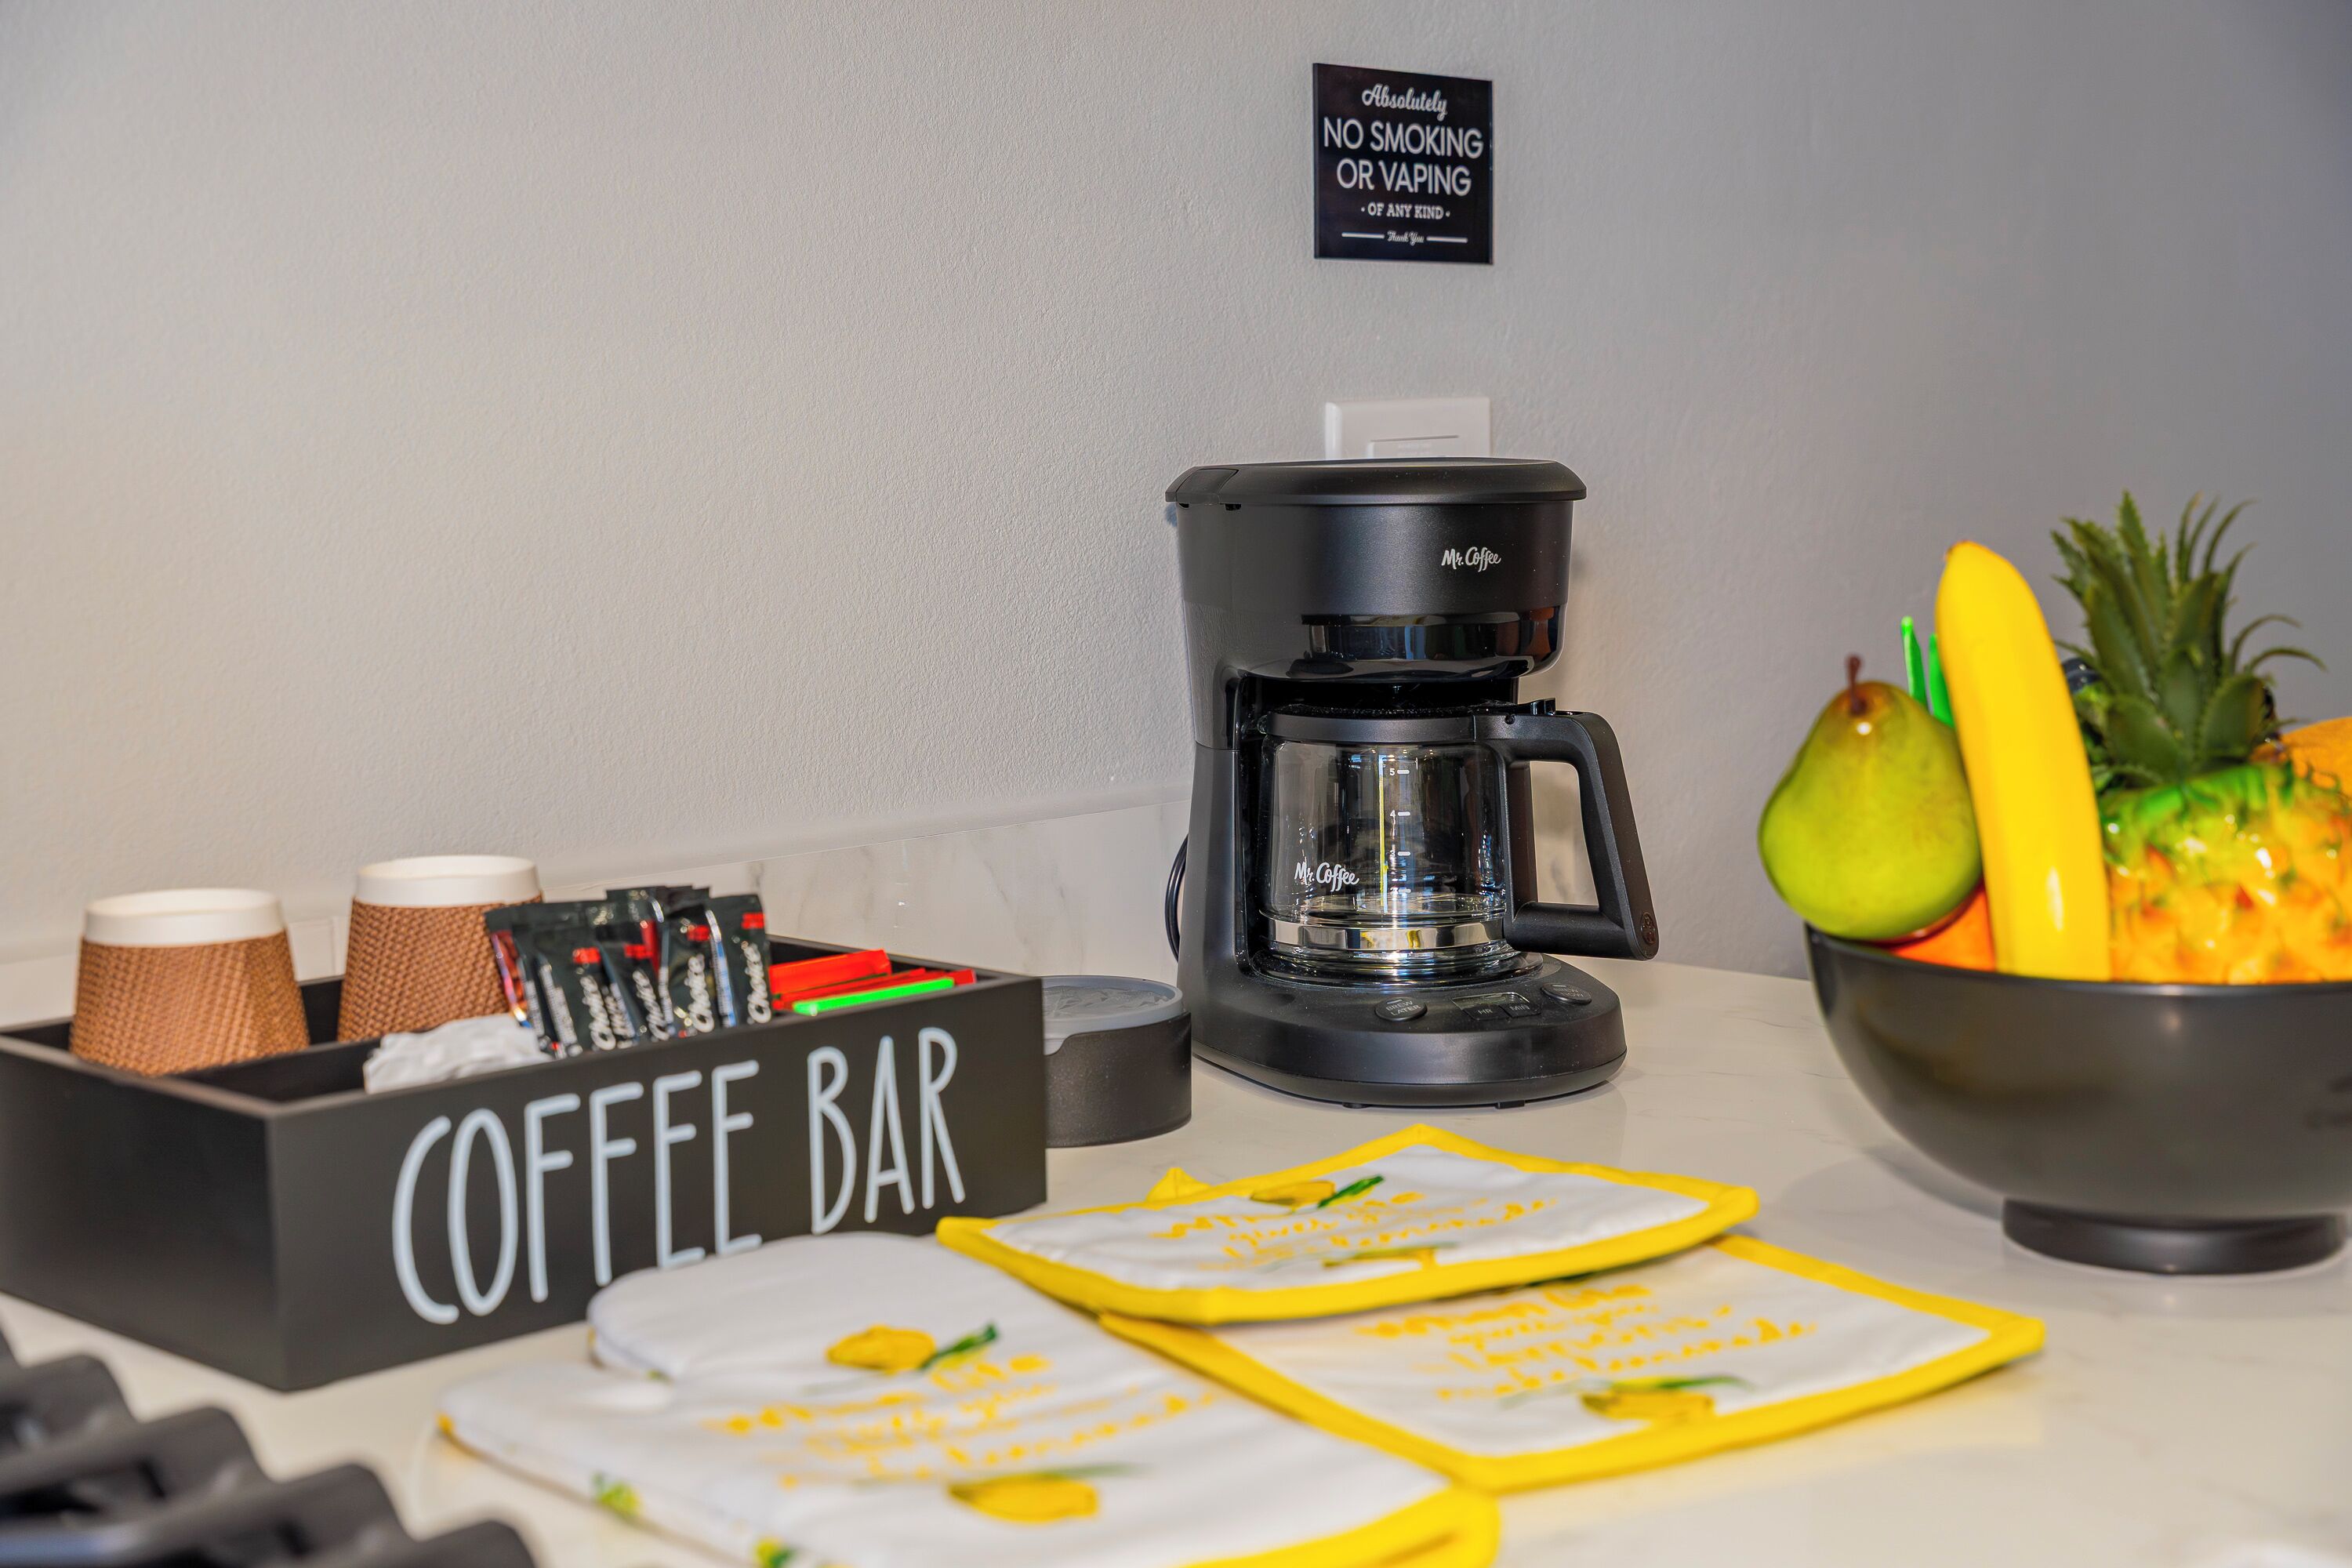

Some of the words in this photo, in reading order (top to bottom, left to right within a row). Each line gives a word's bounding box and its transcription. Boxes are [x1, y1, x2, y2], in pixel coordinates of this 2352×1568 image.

[1362, 83, 1448, 122] Absolutely
[1323, 117, 1364, 150] NO
[1370, 120, 1484, 159] SMOKING
[1337, 158, 1374, 190] OR
[1378, 160, 1472, 196] VAPING
[1367, 201, 1385, 216] OF
[1386, 202, 1413, 218] ANY
[1414, 204, 1444, 220] KIND
[1387, 230, 1409, 242] Thank
[1409, 230, 1425, 246] You
[1441, 548, 1465, 569] Mr.
[1465, 546, 1501, 572] Coffee
[1389, 768, 1396, 776] 5
[1294, 862, 1316, 885] Mr.
[1316, 862, 1359, 892] Coffee
[1385, 1001, 1413, 1011] BREW
[1391, 1005, 1421, 1016] LATER
[392, 1060, 762, 1323] COFFEE
[808, 1026, 966, 1234] BAR
